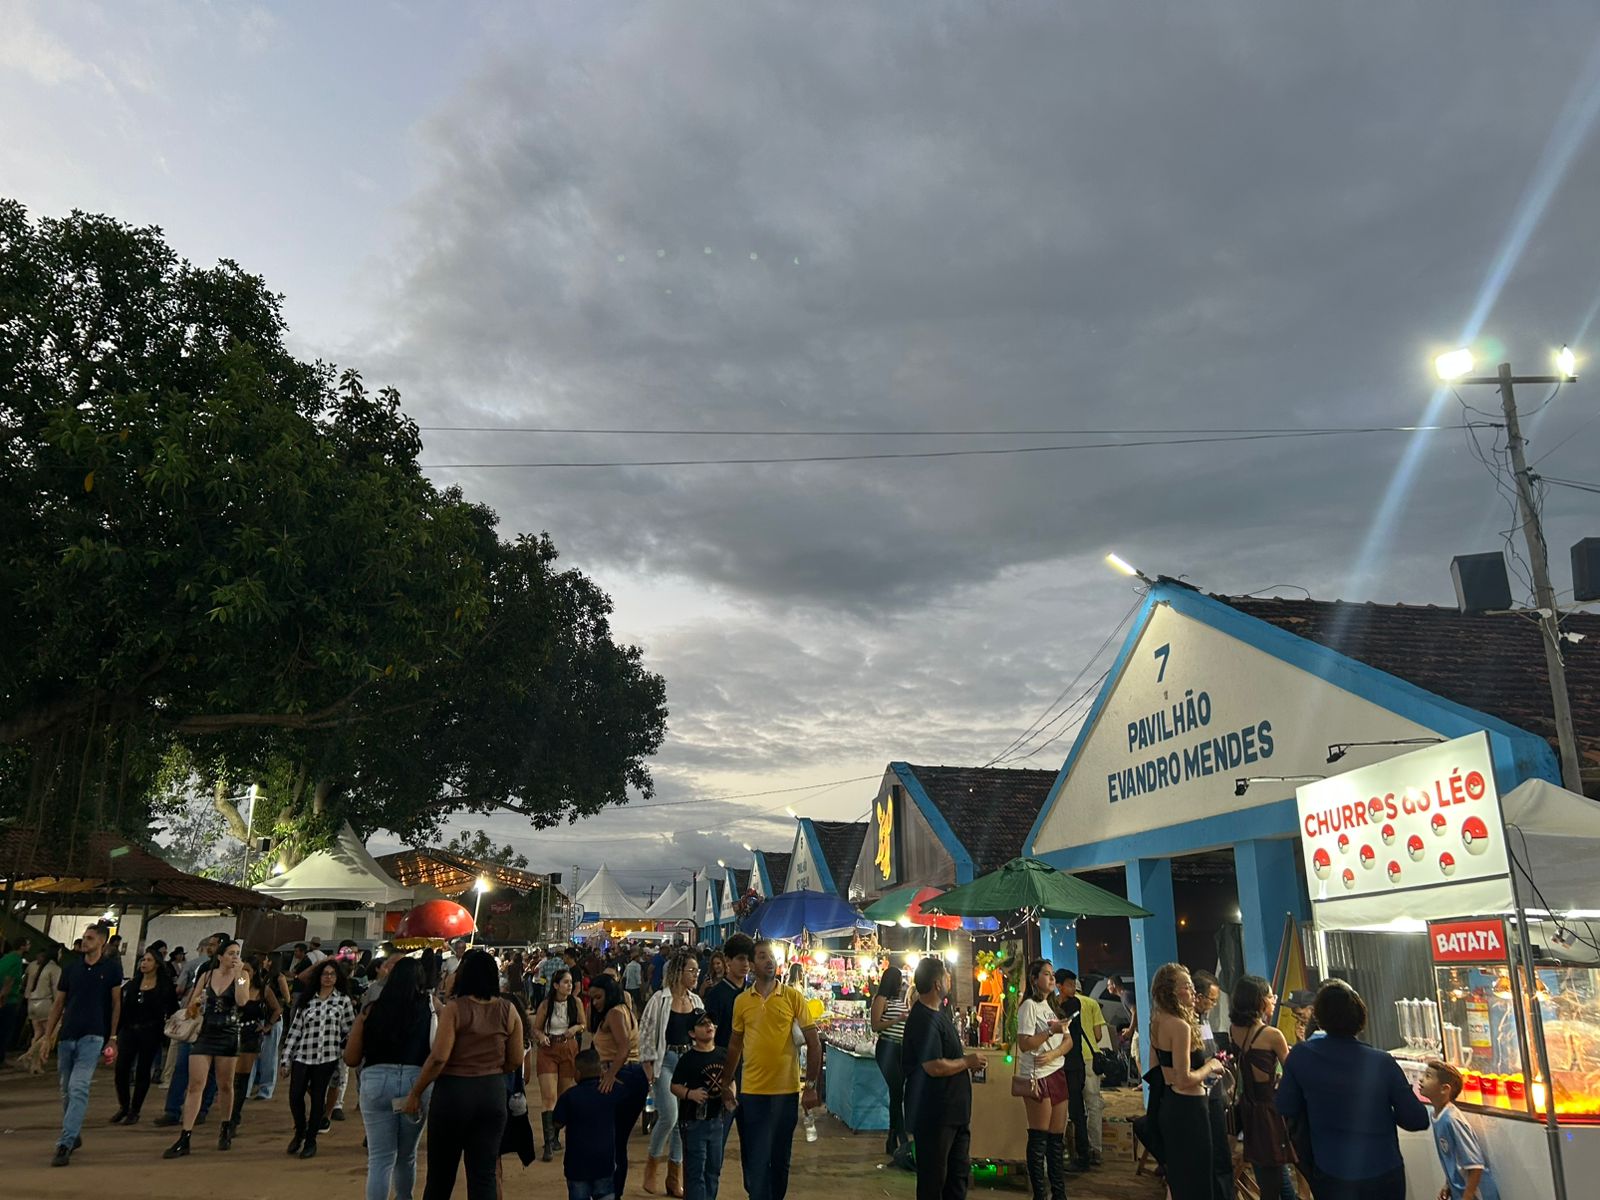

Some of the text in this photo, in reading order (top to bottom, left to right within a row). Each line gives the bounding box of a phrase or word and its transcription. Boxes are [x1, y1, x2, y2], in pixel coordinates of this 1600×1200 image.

[1155, 643, 1170, 683] 7
[1127, 688, 1212, 754] PAVILHÃO
[1107, 719, 1275, 805] EVANDRO MENDES
[1304, 792, 1399, 839] CHURROS
[1434, 766, 1486, 808] LÉO
[1435, 929, 1502, 954] BATATA
